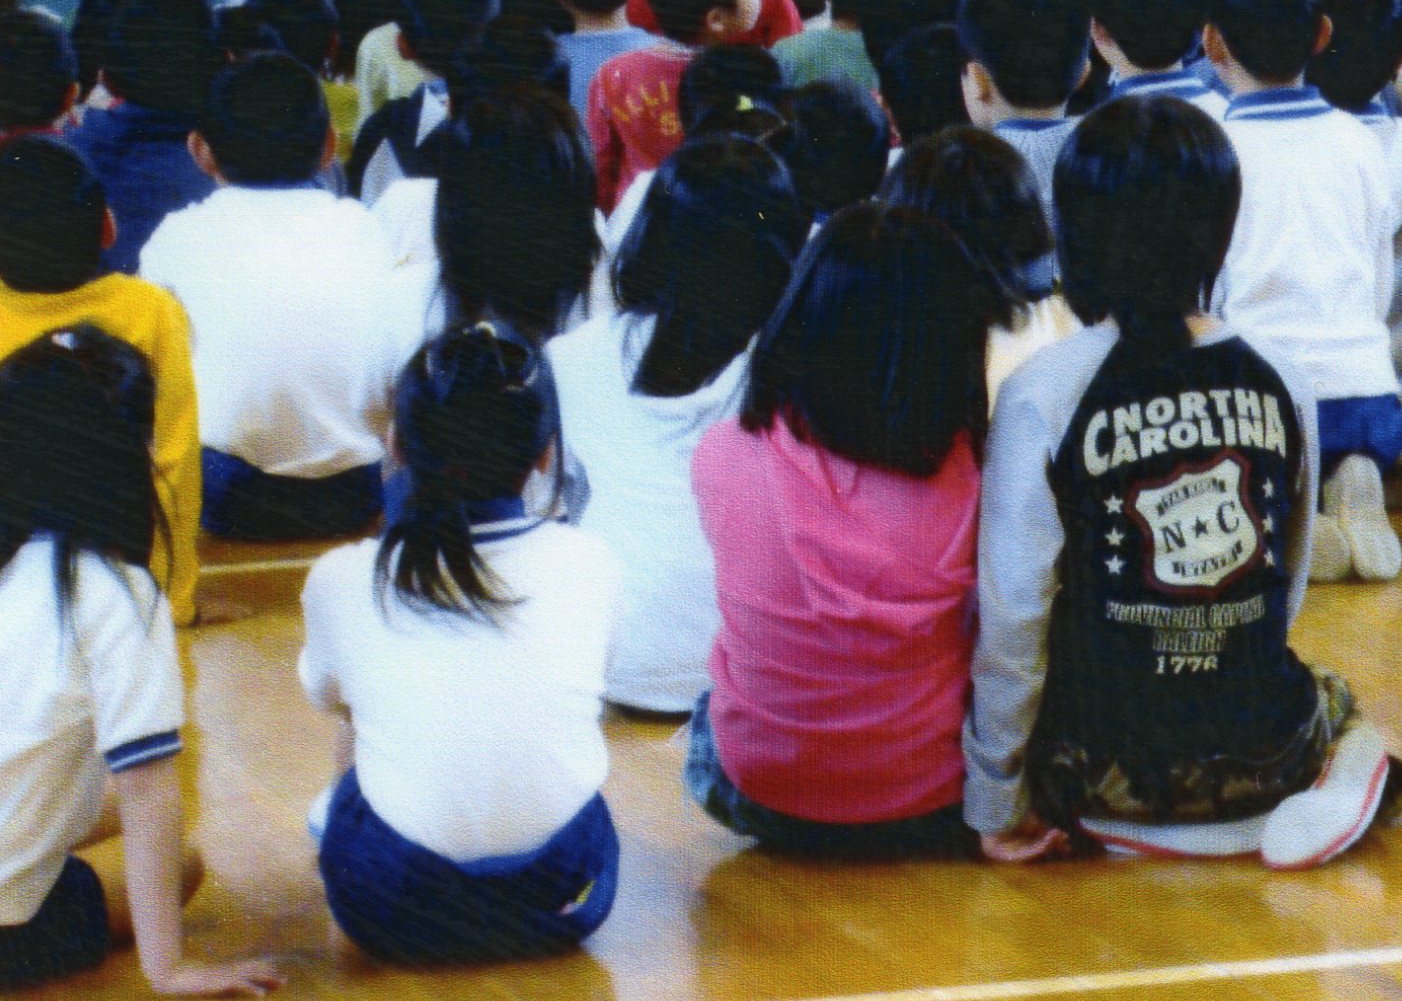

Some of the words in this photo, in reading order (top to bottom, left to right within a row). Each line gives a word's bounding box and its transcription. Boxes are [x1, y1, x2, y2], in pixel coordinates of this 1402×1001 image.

[1083, 394, 1286, 477] CAROLINA
[1112, 388, 1262, 436] NORTH
[1161, 520, 1187, 554] N
[1216, 500, 1240, 534] C
